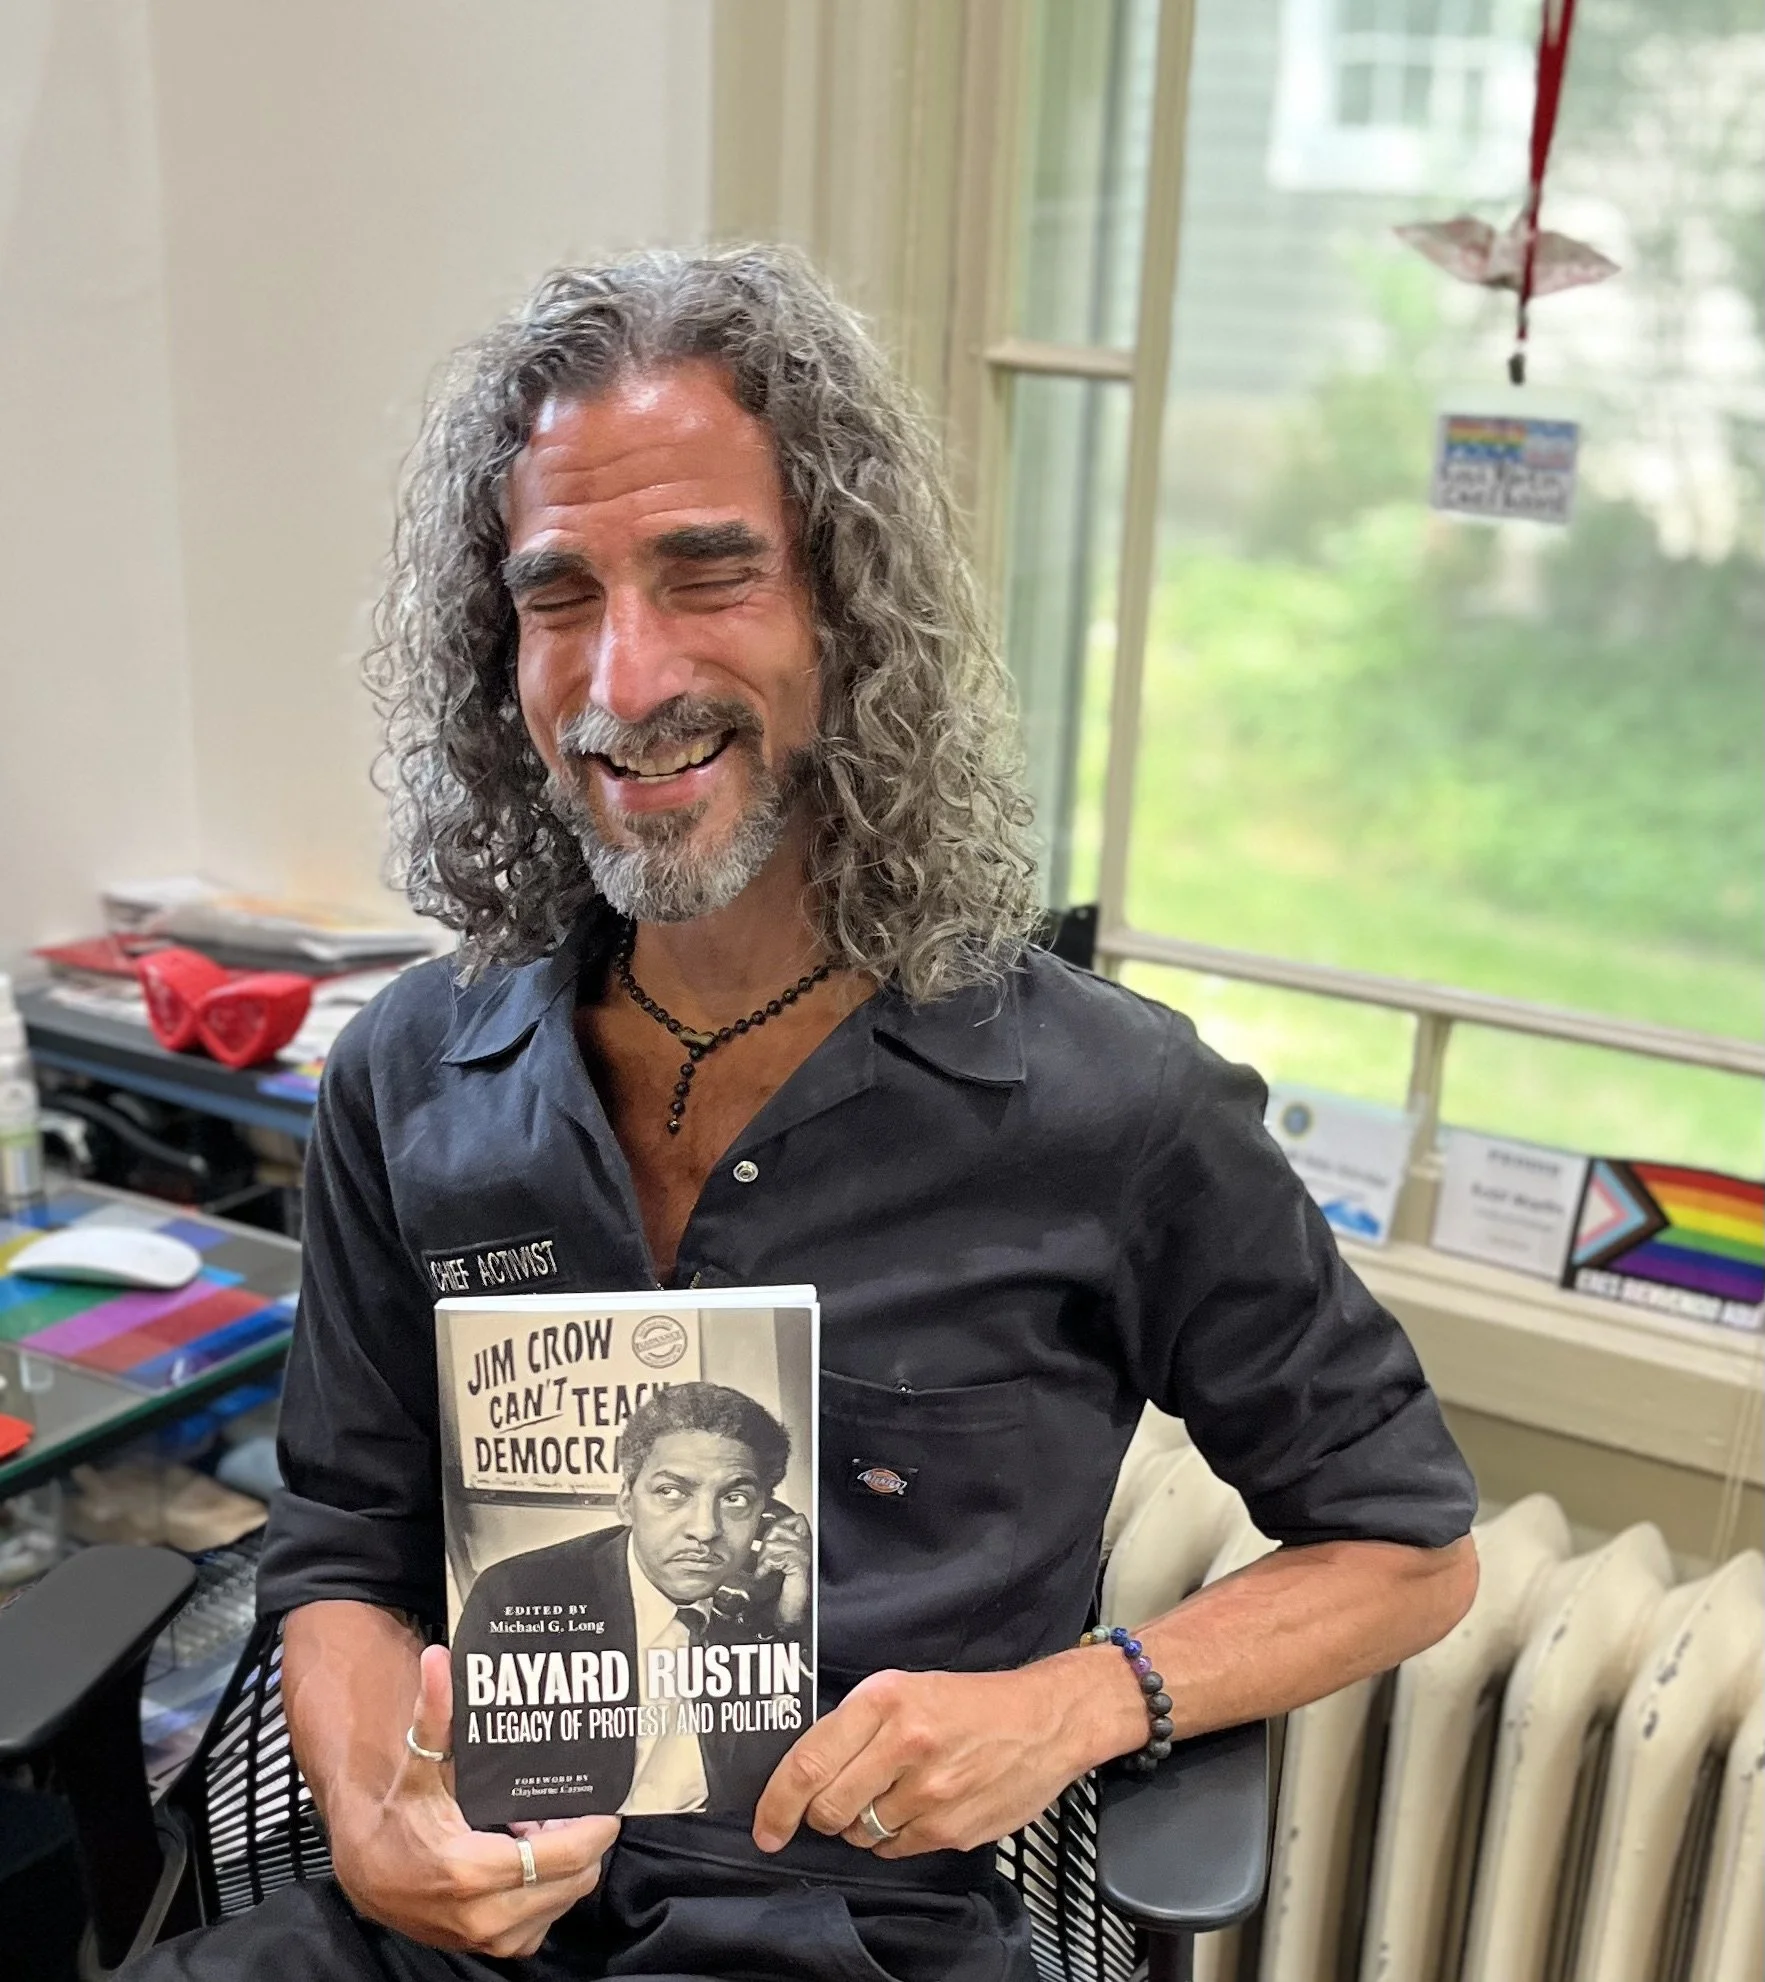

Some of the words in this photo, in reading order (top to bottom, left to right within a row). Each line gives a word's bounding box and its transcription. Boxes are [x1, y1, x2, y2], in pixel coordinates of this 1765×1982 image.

[430, 1258, 469, 1292] CHIEF
[477, 1240, 558, 1287] ACTIVIST
[468, 1338, 516, 1395] JIM
[528, 1317, 613, 1373] CROW
[490, 1376, 568, 1429] CAN'T
[572, 1382, 670, 1427] TEAC
[489, 1620, 545, 1633] Michael
[548, 1620, 565, 1633] G.
[568, 1620, 605, 1634] Long
[504, 1605, 563, 1616] EDITED
[568, 1604, 588, 1615] BY
[466, 1650, 630, 1706] BAYARD
[647, 1642, 801, 1699] RUSTIN
[467, 1711, 481, 1743] A
[486, 1709, 554, 1743] LEGACY
[560, 1709, 582, 1742] OF
[589, 1706, 668, 1739] PROTEST
[677, 1703, 714, 1735] AND
[721, 1698, 802, 1734] POLITICS
